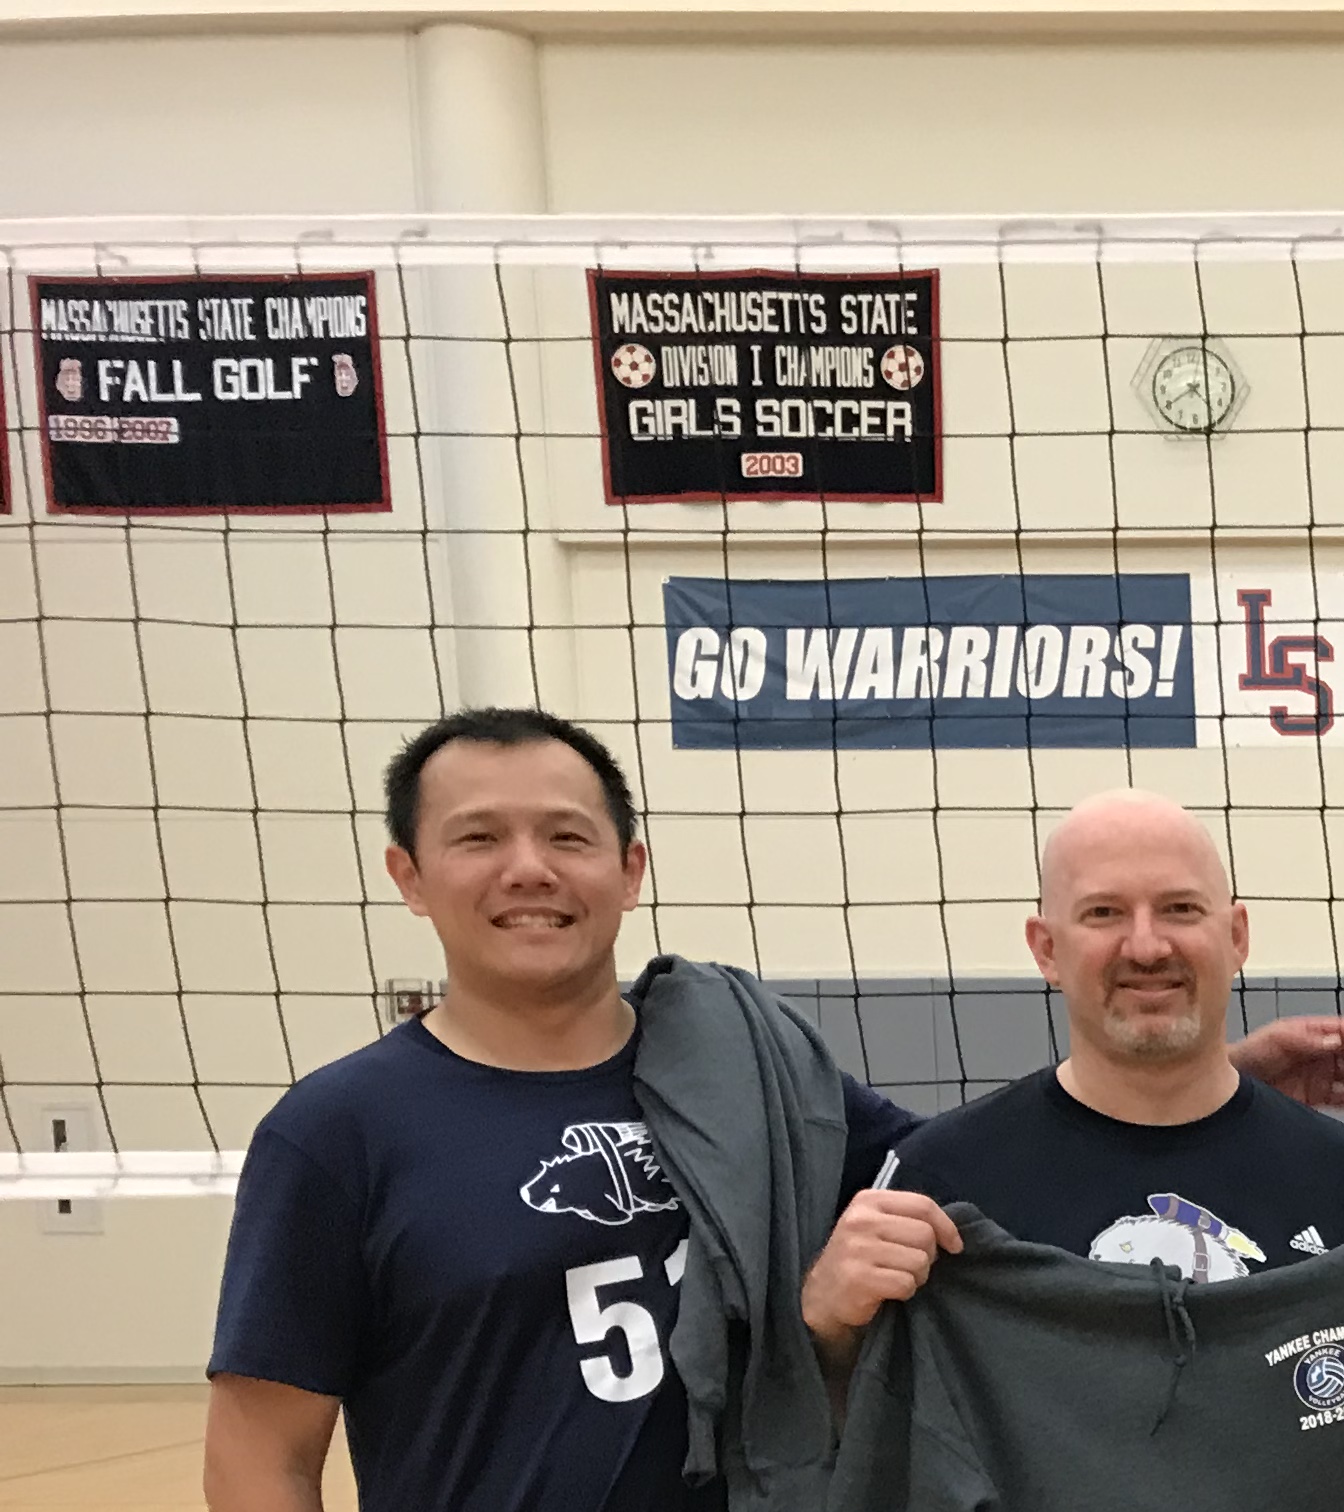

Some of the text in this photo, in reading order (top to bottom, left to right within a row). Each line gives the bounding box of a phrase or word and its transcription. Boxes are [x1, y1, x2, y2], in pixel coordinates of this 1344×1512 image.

[40, 296, 367, 343] MASSACHUSETTS STATE CHAMPIONS
[609, 291, 919, 334] MASSACHUSETTS STATE
[97, 357, 319, 402] FALL GOLF
[661, 345, 874, 388] DIVISION I CHAMPIONS
[628, 398, 912, 442] GIRLS SOCCER
[745, 455, 799, 476] 2003
[672, 624, 1184, 702] GO WARRIORS!
[1236, 589, 1334, 737] LS
[565, 1239, 688, 1403] 5
[1265, 1335, 1311, 1366] YANKEE
[1304, 1347, 1341, 1364] YANKEE
